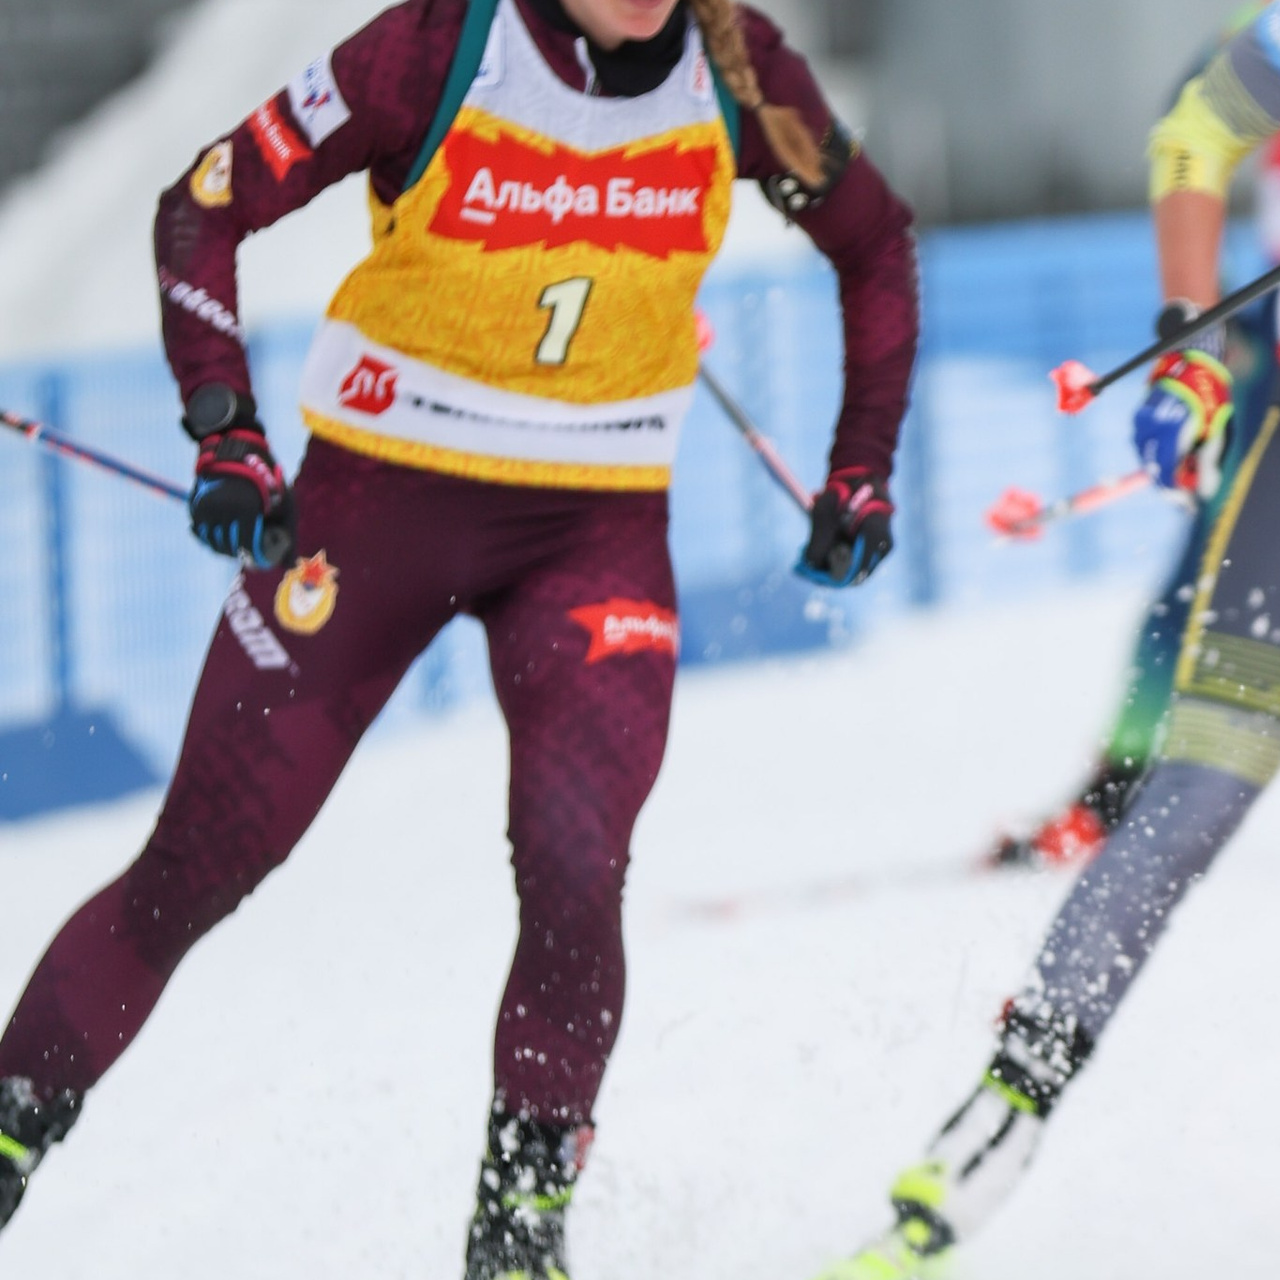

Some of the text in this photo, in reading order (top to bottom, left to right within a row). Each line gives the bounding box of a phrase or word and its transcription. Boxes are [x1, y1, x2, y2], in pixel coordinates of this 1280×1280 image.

[460, 167, 701, 224] Альфа Банк
[535, 275, 594, 365] 1
